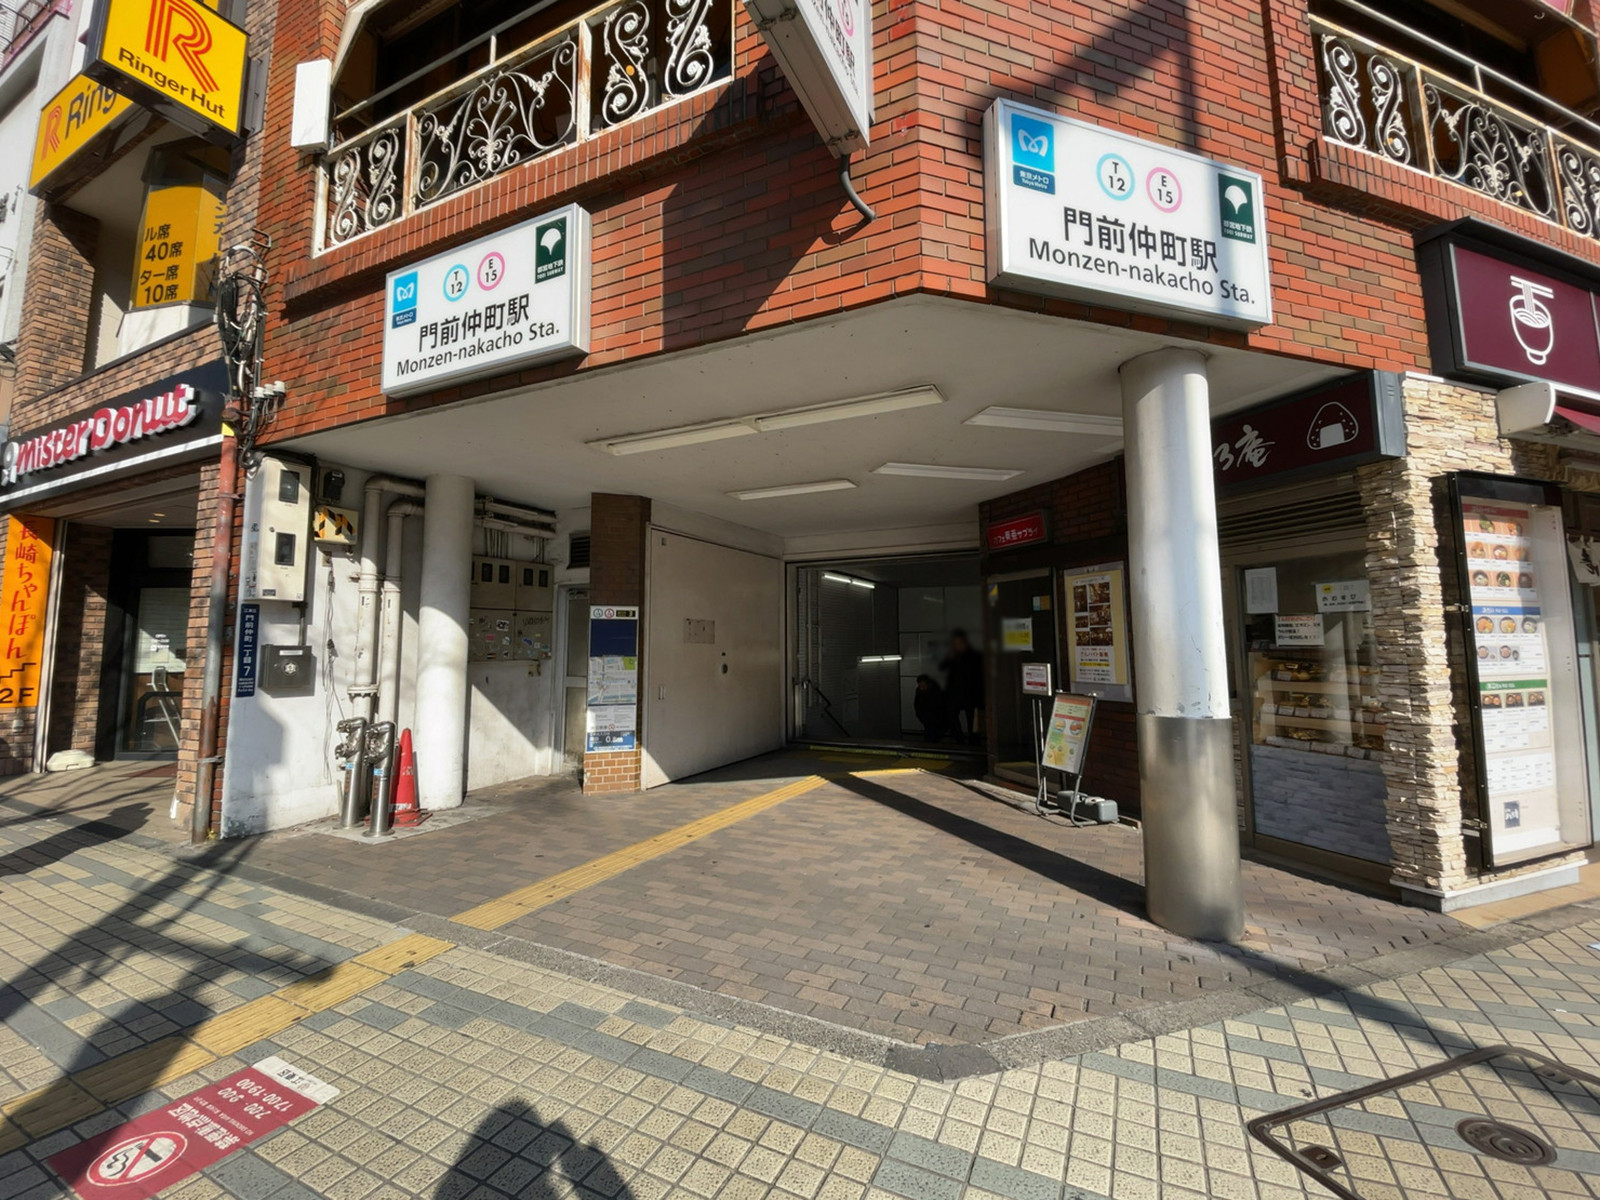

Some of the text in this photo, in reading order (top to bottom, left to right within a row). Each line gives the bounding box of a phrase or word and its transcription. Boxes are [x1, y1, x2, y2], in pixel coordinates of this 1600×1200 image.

[118, 47, 226, 119] Ringer Hut
[1111, 161, 1119, 175] T
[1108, 175, 1126, 192] 12
[1160, 175, 1168, 188] E
[1157, 188, 1173, 204] 15
[1063, 206, 1219, 274] 門前仲町駅
[145, 241, 183, 262] 40席
[488, 258, 494, 270] E
[1028, 237, 1256, 305] Monzen-nakacho Sta.
[140, 264, 179, 286] ター席
[453, 270, 460, 281] T
[485, 270, 498, 283] 15
[144, 284, 179, 304] 10席
[450, 281, 463, 295] 12
[419, 293, 530, 353] 門前仲町駅
[396, 320, 560, 377] Monzen-nakacho Sta.
[6, 522, 38, 660] 長崎ちゃんぽん
[243, 666, 251, 676] 7
[0, 687, 34, 704] 2F
